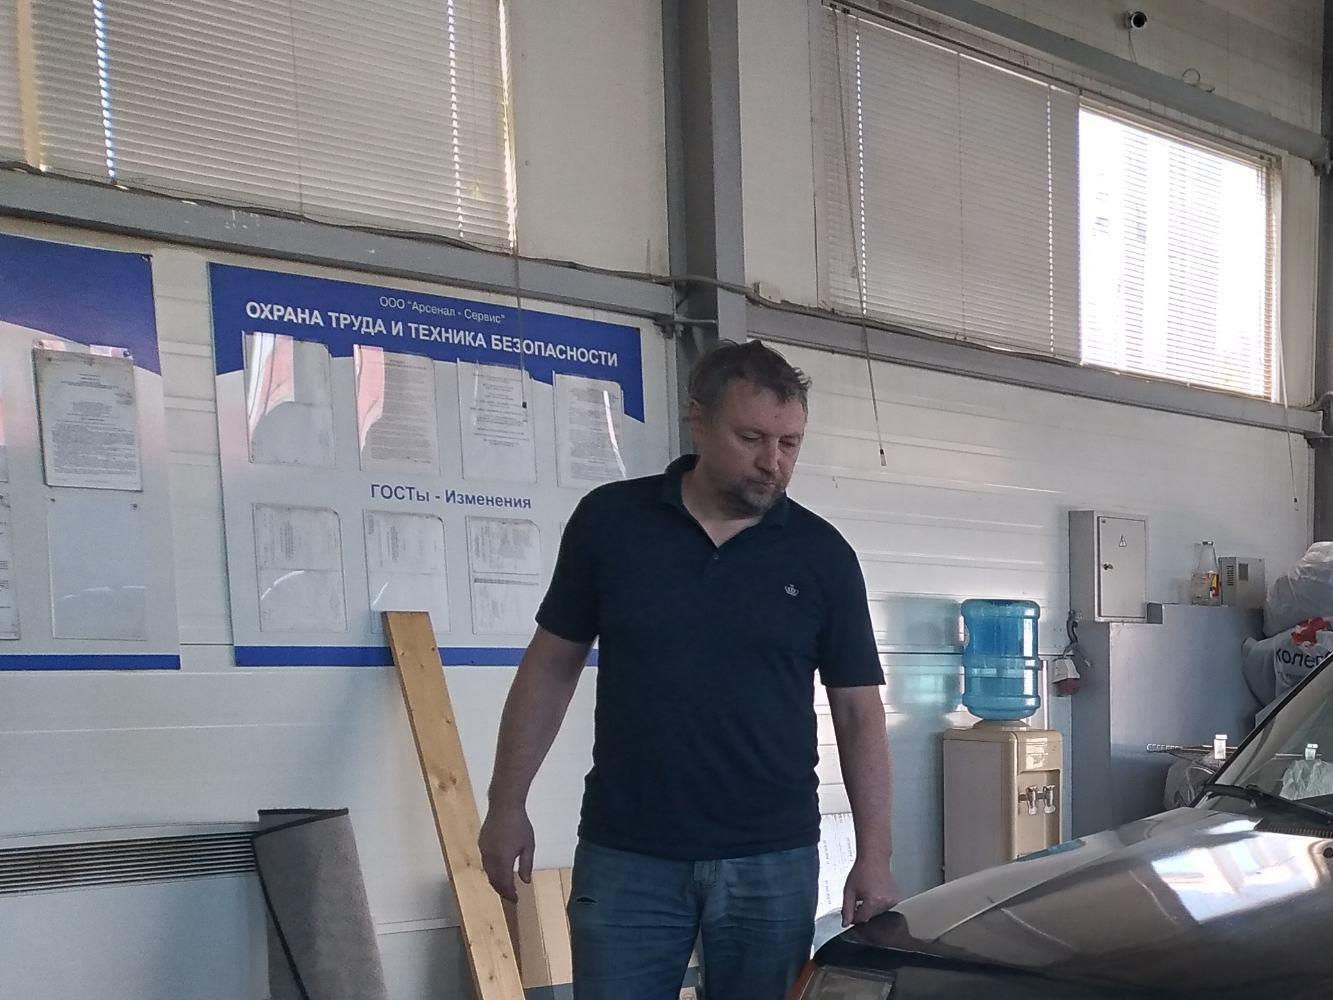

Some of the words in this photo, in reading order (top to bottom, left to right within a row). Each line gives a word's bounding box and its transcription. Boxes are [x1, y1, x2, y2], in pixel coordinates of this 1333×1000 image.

[379, 296, 405, 310] ООО
[407, 301, 456, 317] "Арсенал
[464, 308, 506, 324] Сервис"
[245, 301, 325, 328] ОХРАНА
[327, 311, 387, 336] ТРУДА
[391, 320, 403, 336] И
[407, 322, 487, 349] ТЕХНИКА
[491, 334, 618, 367] БЕЗОПАСНОСТИ
[371, 484, 430, 502] ГОСТы
[445, 489, 532, 509] Изменения
